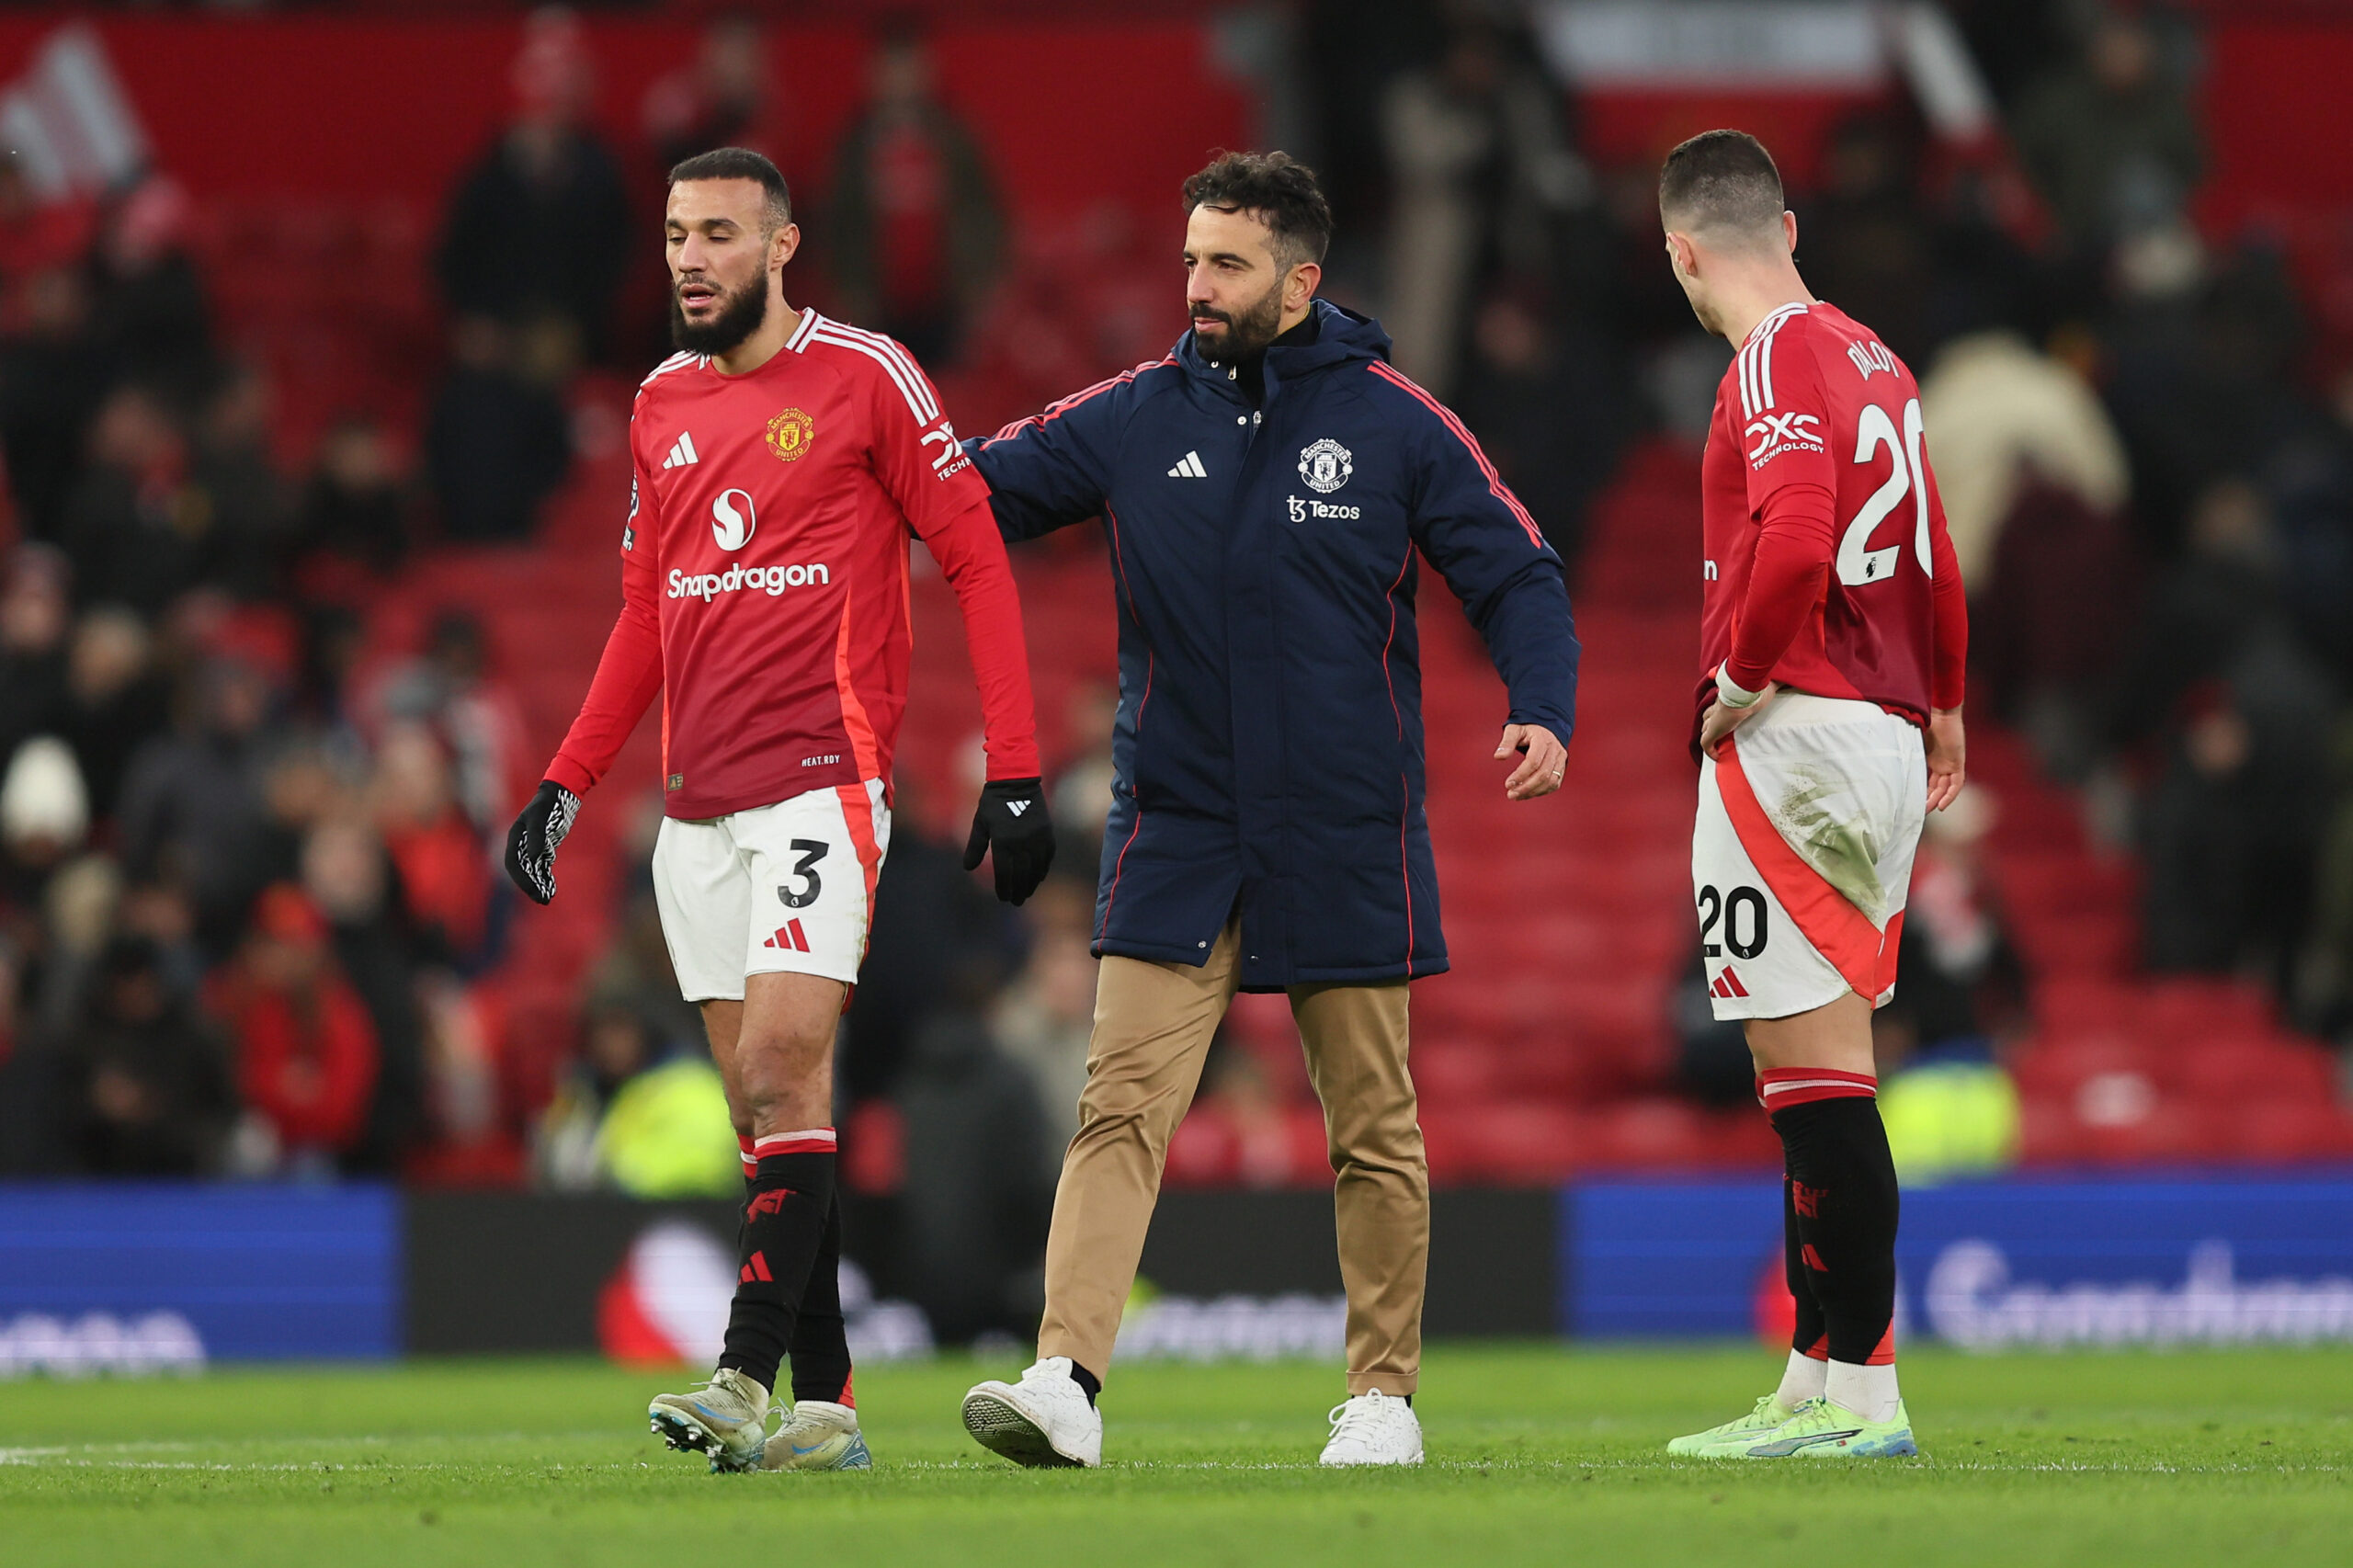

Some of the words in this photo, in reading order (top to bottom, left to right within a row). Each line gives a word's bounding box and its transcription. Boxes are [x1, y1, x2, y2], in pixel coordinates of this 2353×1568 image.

[1847, 340, 1900, 381] DALOT
[771, 412, 810, 429] MANCHESTER
[1745, 412, 1824, 460] DXC
[776, 448, 804, 458] UNITED
[1304, 442, 1348, 461] MANCHESTER
[1752, 442, 1824, 471] TECHNOLOGY
[938, 457, 972, 482] TECHN
[1309, 480, 1341, 490] UNITED
[1309, 500, 1360, 519] Tezos
[667, 562, 829, 603] Snapdragon
[801, 754, 840, 767] HEAT.RDY
[778, 838, 830, 909] 3
[1698, 884, 1768, 960] 20
